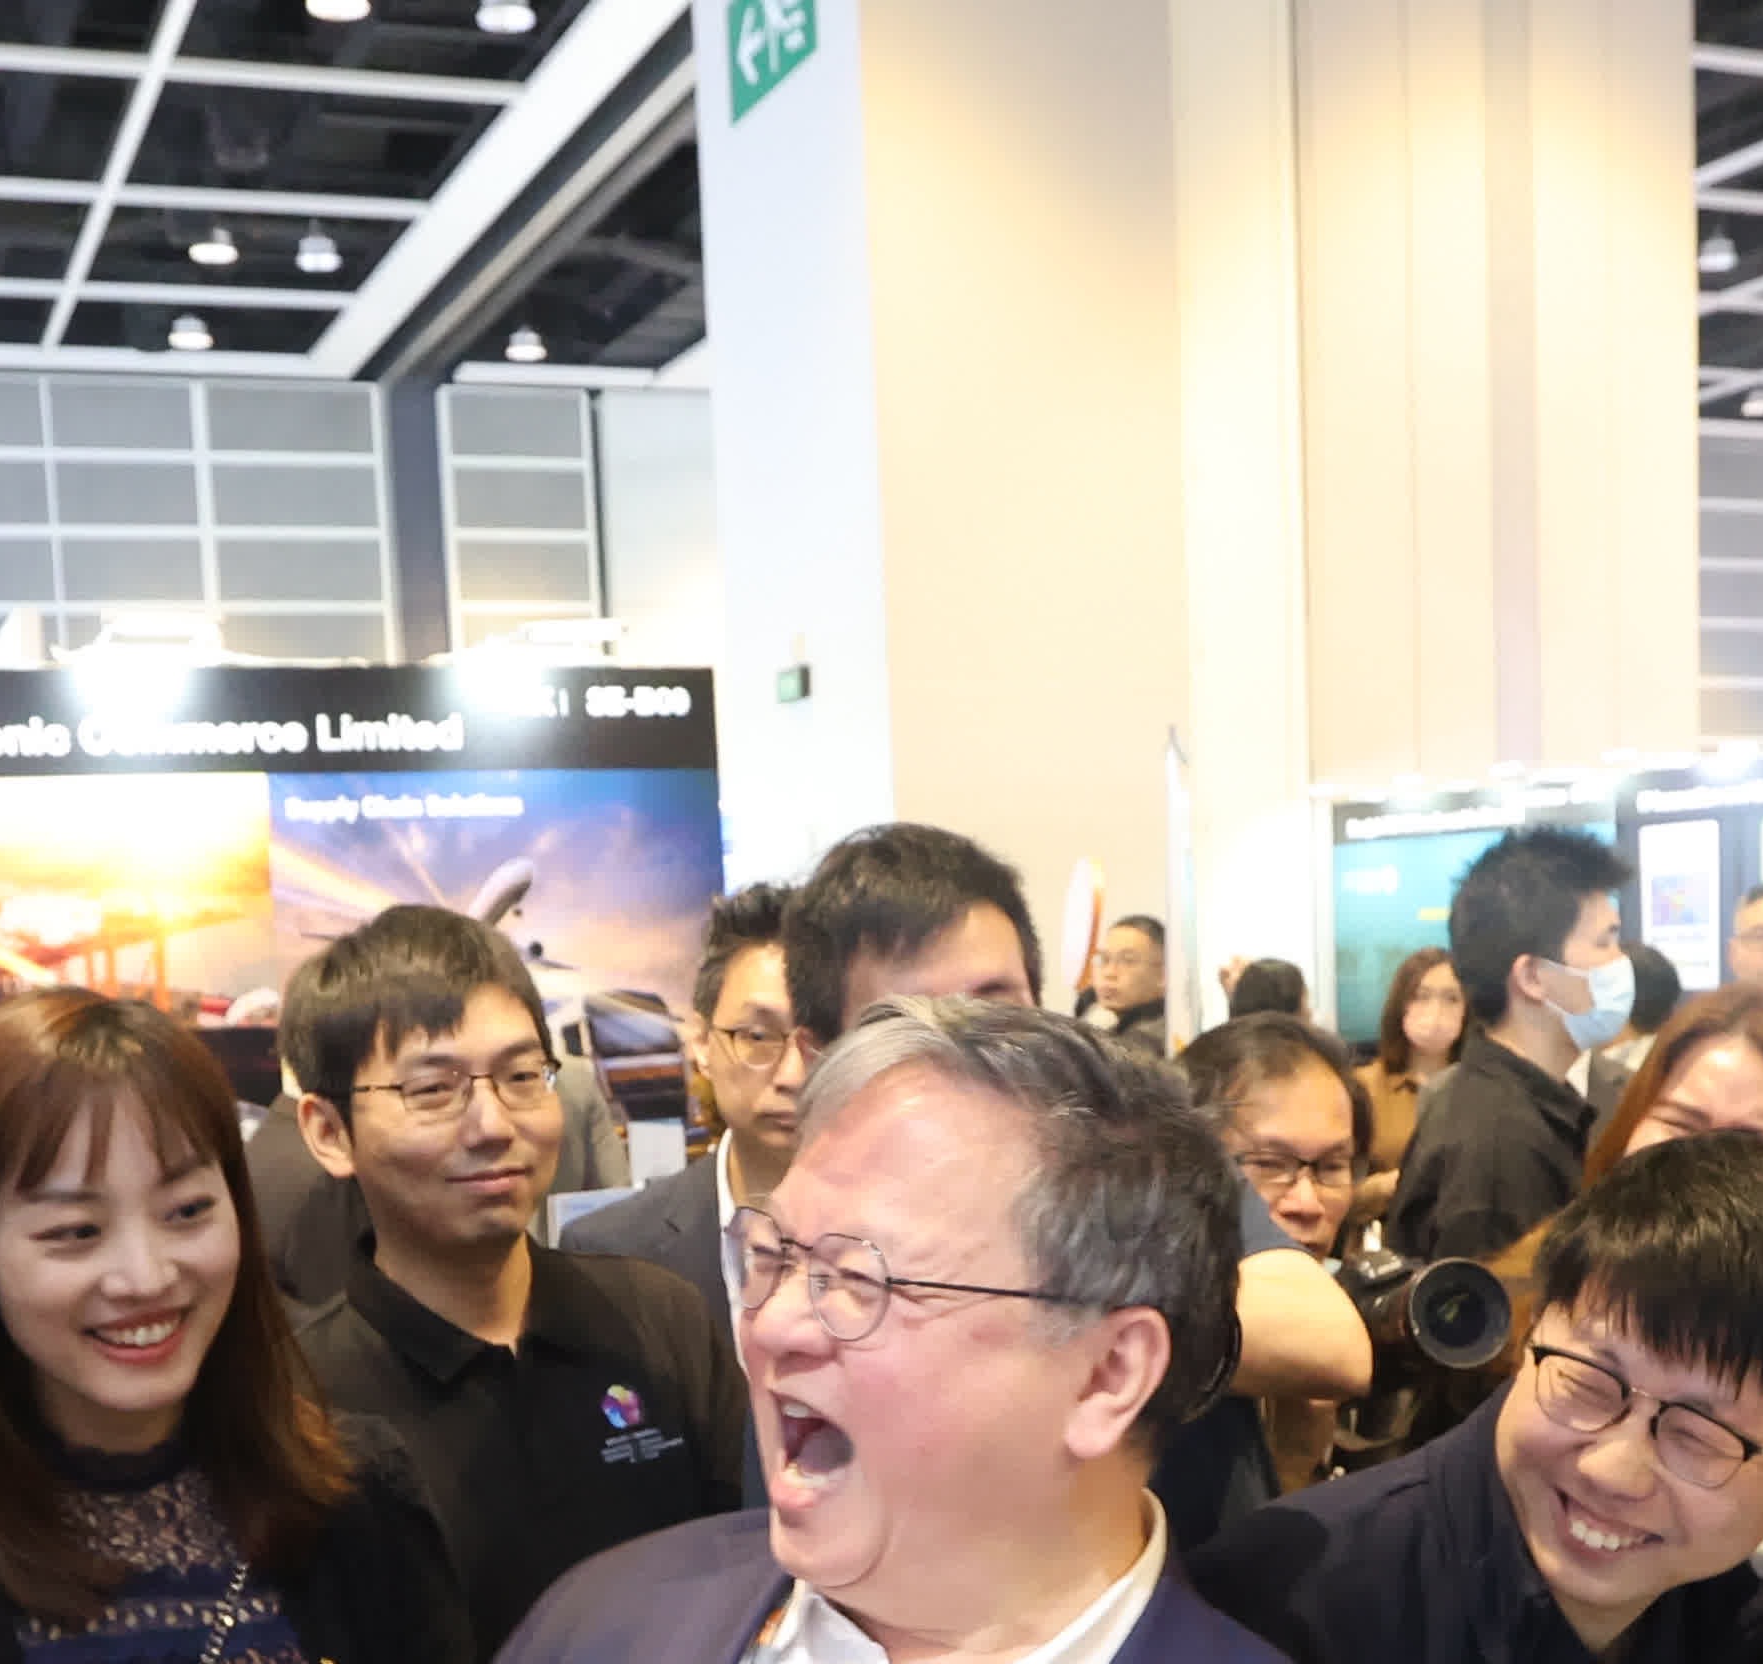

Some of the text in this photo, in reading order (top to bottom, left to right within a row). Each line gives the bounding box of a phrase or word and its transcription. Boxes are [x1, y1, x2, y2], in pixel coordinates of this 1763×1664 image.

[78, 713, 308, 756] Commerce
[316, 713, 464, 752] Limited
[284, 796, 359, 824] Supply
